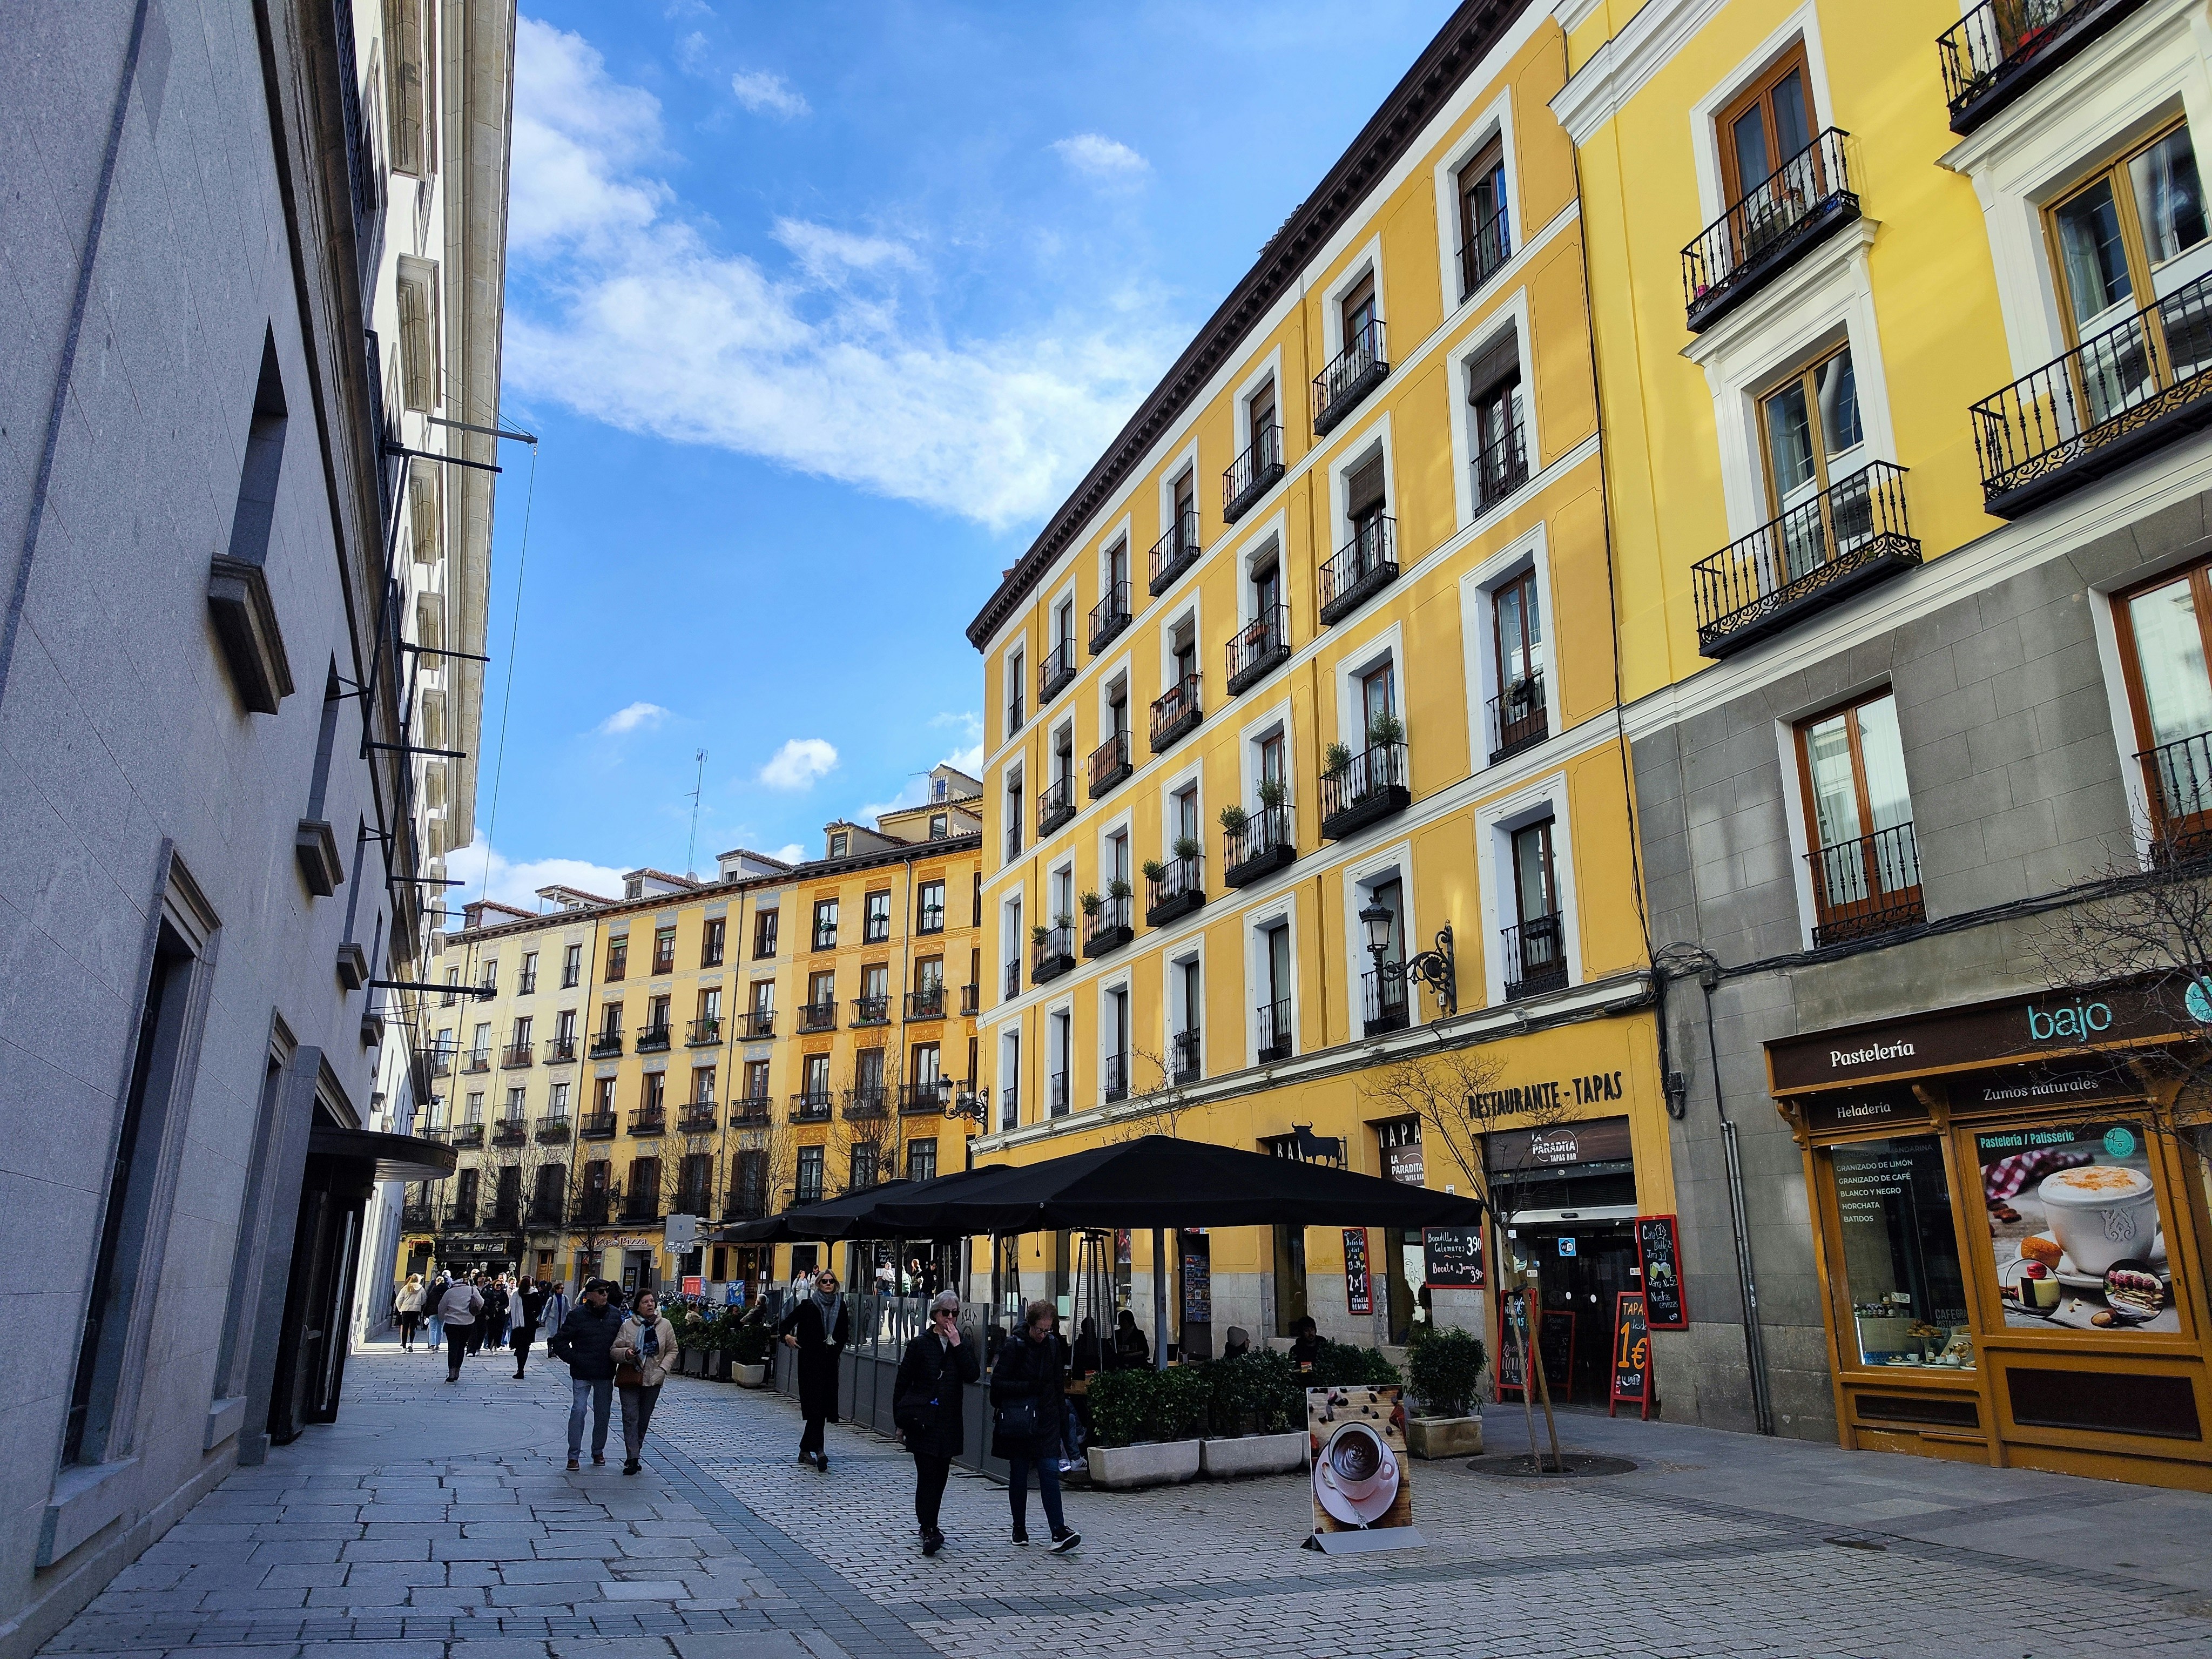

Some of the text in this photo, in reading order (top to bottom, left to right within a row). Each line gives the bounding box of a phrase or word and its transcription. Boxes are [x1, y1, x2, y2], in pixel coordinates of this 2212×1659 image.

[2027, 997, 2113, 1042] bajo
[1830, 1040, 1916, 1067] Pastelería
[1984, 1077, 2099, 1101] Zumos naturales
[1467, 1081, 1561, 1120] RESTAURANTE
[1572, 1071, 1622, 1105] TAPAS
[1837, 1102, 1891, 1118] Heladería
[1532, 1132, 1542, 1142] LA
[1980, 1134, 2022, 1149] Pastelería
[2030, 1130, 2074, 1145] Patisserie
[1532, 1140, 1576, 1155] PARADITA
[1391, 1155, 1399, 1164] LA
[1549, 1152, 1577, 1162] TAPAS BAR
[1391, 1163, 1424, 1175] PARADITA
[1837, 1162, 1877, 1172] GRANIZADO
[1890, 1158, 1913, 1168] LIMÓN
[1838, 1176, 1879, 1184] GRANIZADO
[1892, 1172, 1911, 1181] CAFÉ
[1840, 1189, 1869, 1197] BLANCO
[1842, 1202, 1880, 1210] HORCHATA
[619, 1236, 648, 1245] Pizza
[1428, 1231, 1452, 1243] Bocadillo
[1435, 1243, 1465, 1252] Calamares
[1433, 1262, 1454, 1274] Bocata
[1348, 1273, 1364, 1292] 2x1
[1622, 1302, 1645, 1316] TAPA
